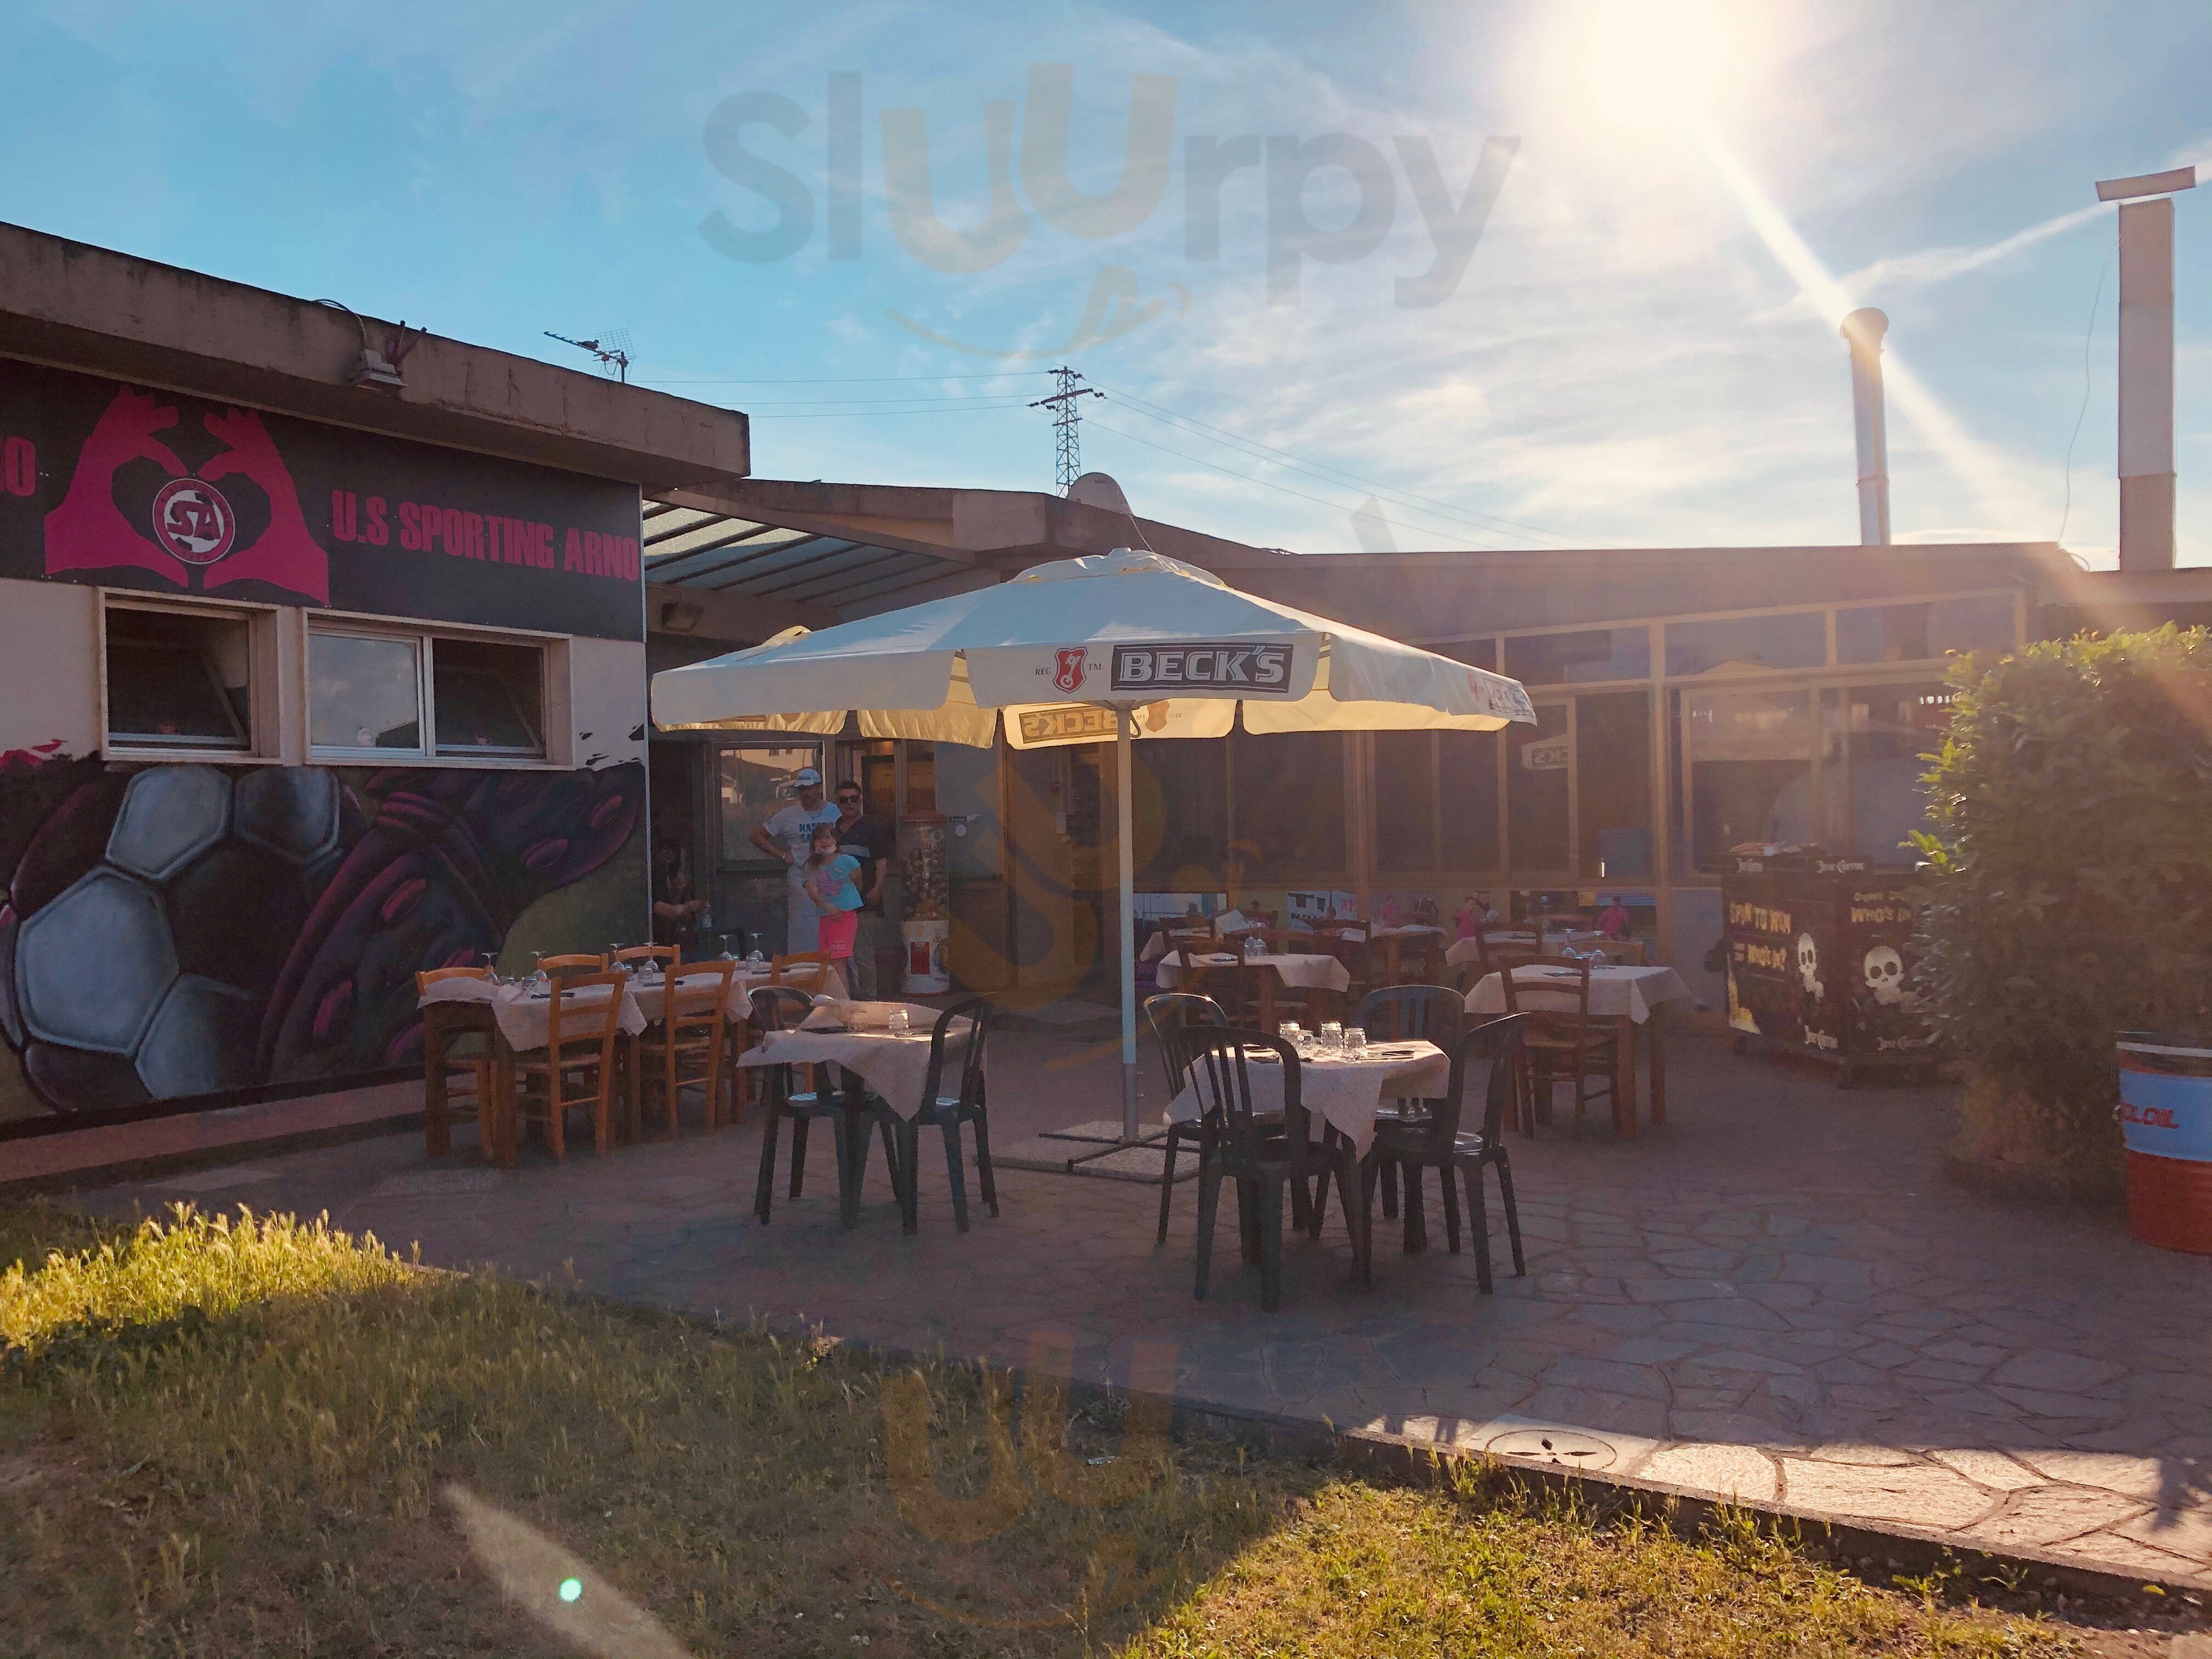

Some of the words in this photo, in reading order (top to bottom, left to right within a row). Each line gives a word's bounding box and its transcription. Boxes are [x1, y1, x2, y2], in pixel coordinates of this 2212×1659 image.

[0, 437, 36, 496] O
[399, 501, 555, 569] SPORTING
[563, 528, 639, 581] ARNO
[1035, 667, 1051, 676] REG
[1088, 663, 1102, 671] TM
[1118, 646, 1285, 684] BECK'S
